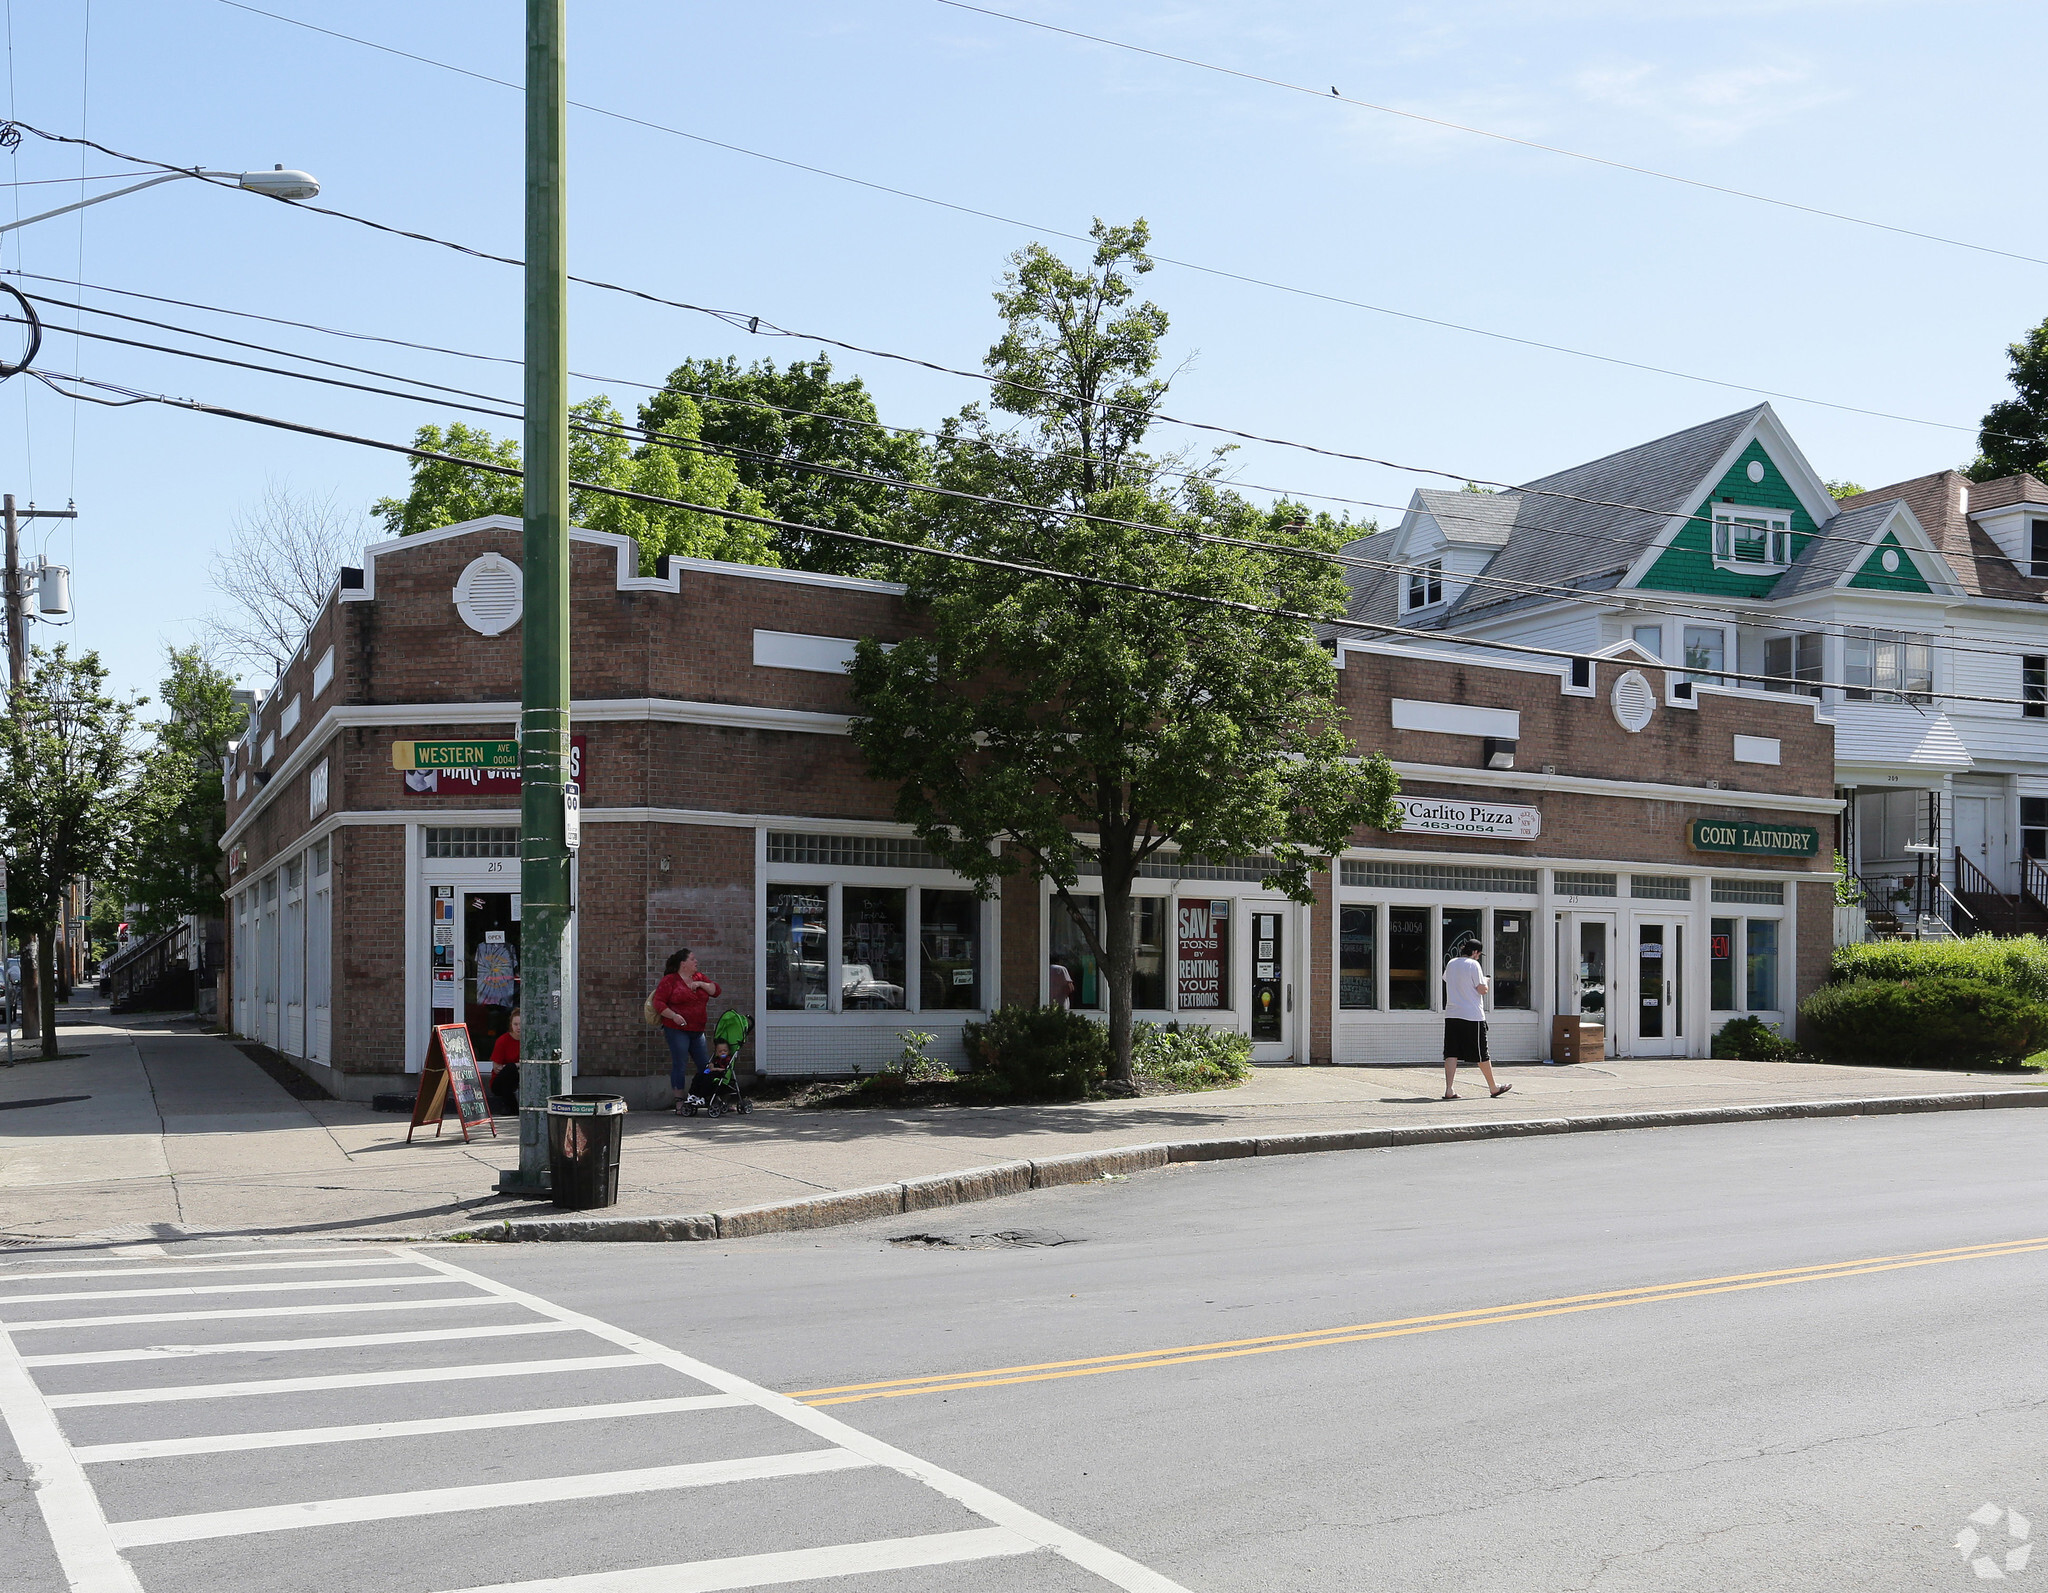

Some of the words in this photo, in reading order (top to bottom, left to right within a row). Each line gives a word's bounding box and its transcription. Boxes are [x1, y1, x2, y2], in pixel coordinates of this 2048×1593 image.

[497, 744, 510, 753] AVE
[419, 746, 484, 764] WESTERN
[493, 755, 515, 764] 00041
[1470, 807, 1513, 825] Pizza
[1420, 821, 1495, 833] 463-0054
[1700, 826, 1736, 846] COIN
[1742, 829, 1811, 850] LAUNDRY
[488, 862, 503, 873] 215
[1568, 895, 1579, 904] 215
[1179, 908, 1218, 939] SAVE
[1180, 940, 1218, 949] TONS
[1179, 960, 1219, 979] RENTING
[1179, 981, 1218, 991] YOUR
[1179, 993, 1219, 1007] TEXTBOOKS
